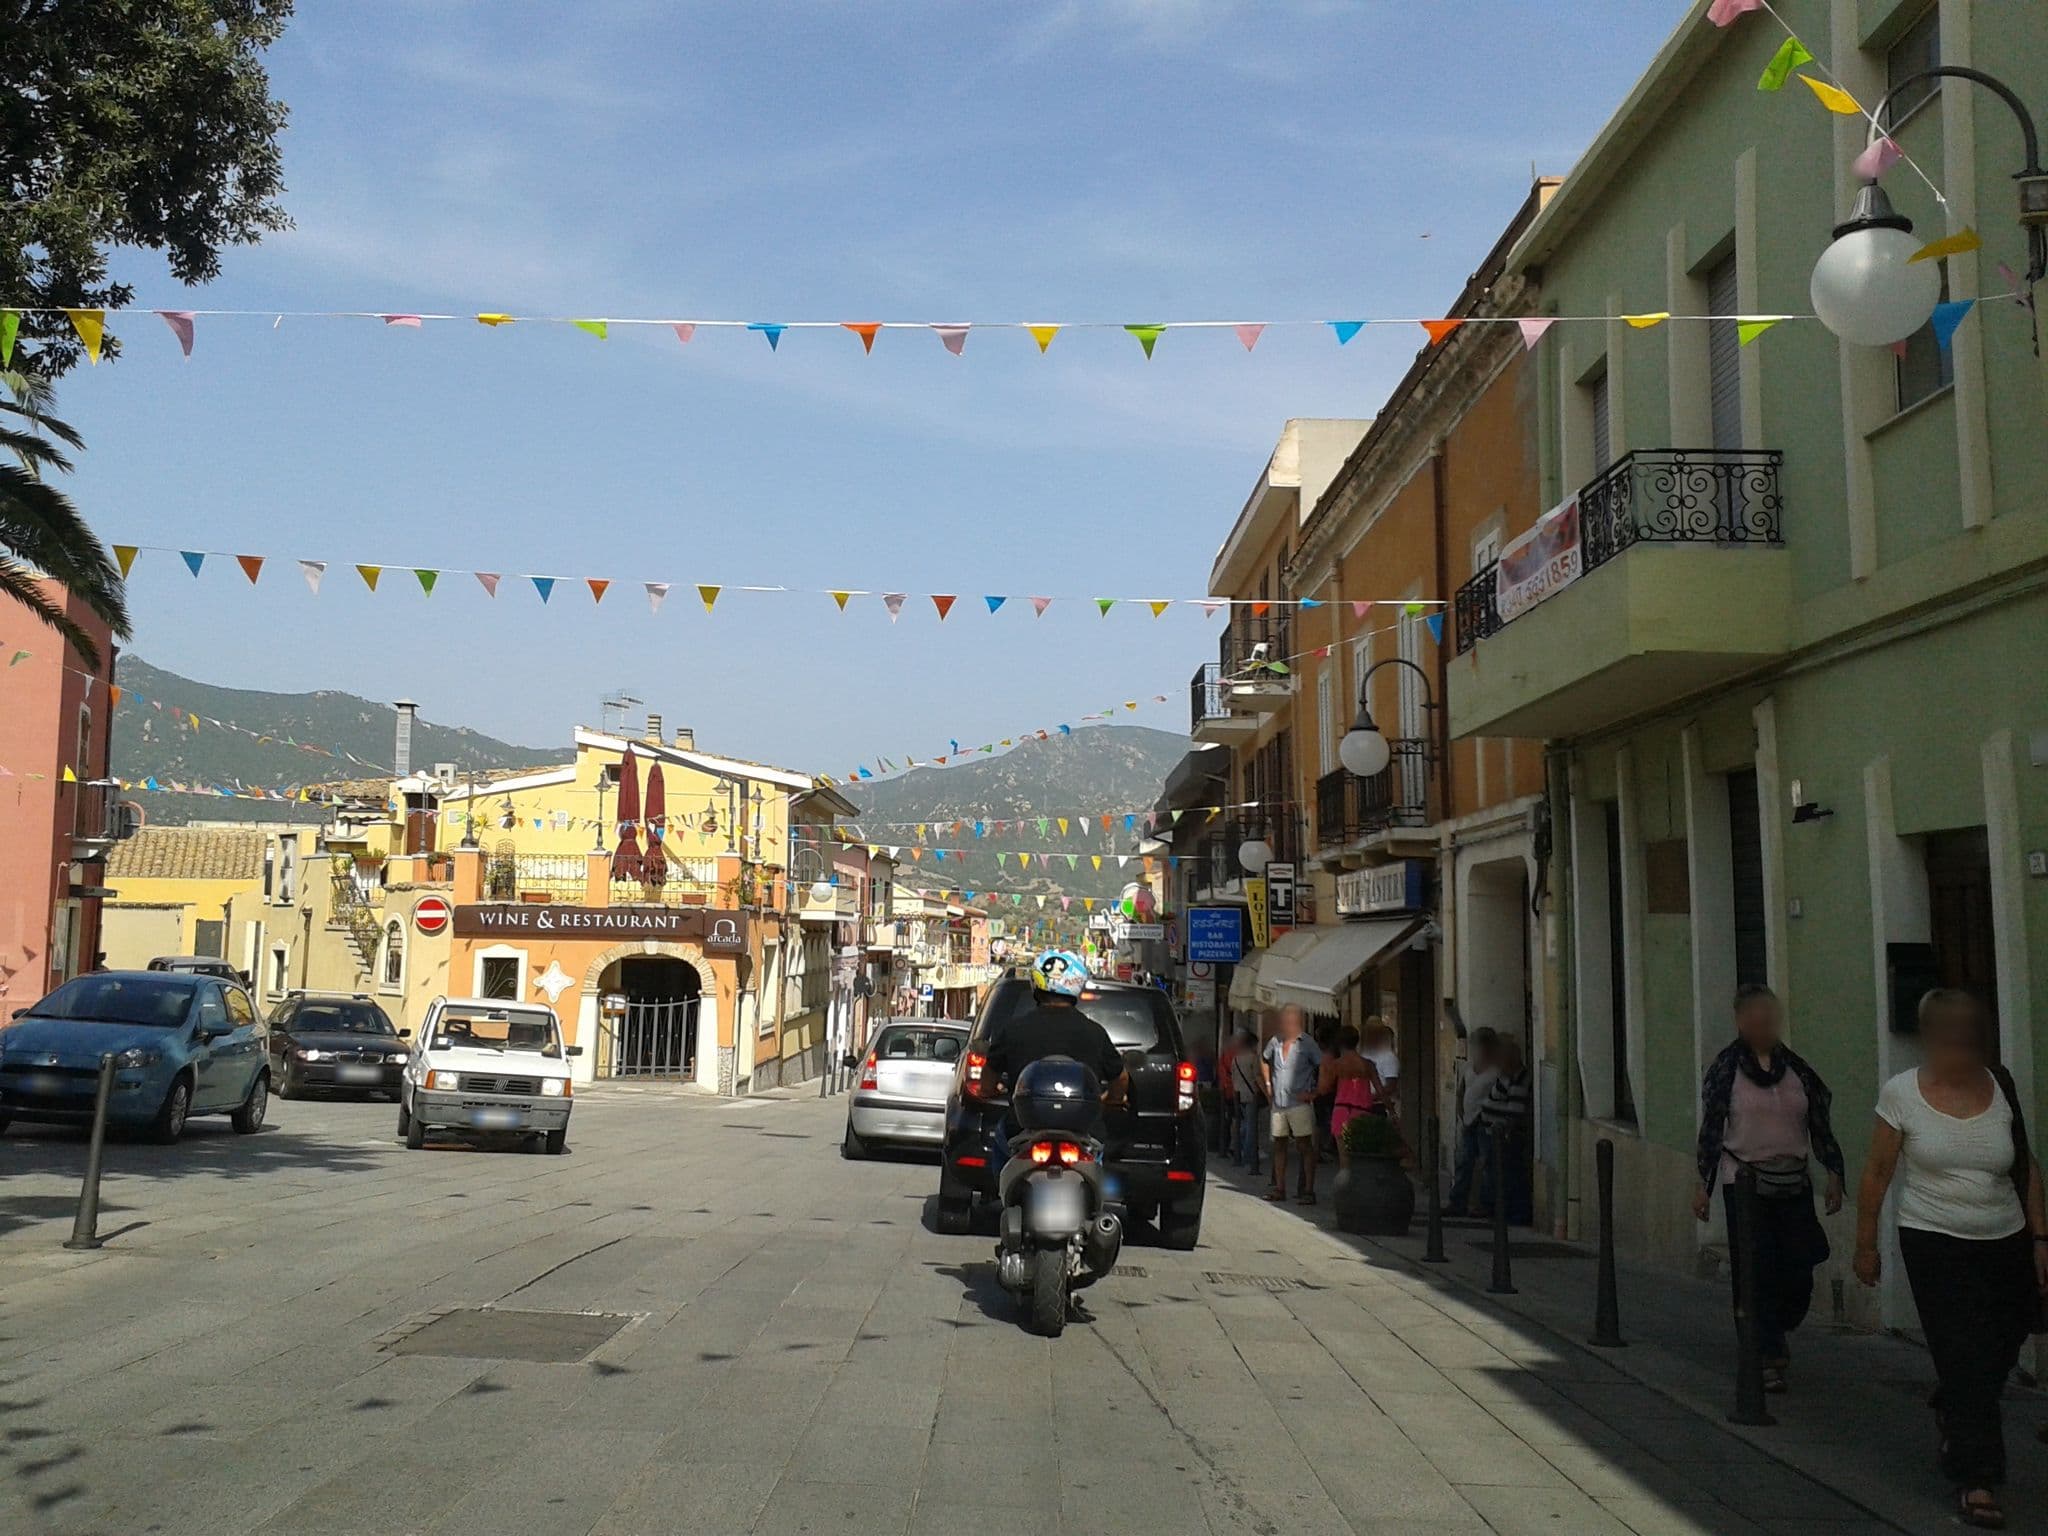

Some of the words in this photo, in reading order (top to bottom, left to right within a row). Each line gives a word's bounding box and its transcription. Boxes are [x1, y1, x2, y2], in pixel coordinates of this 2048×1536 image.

[479, 912, 529, 926] WINE
[537, 910, 555, 929] &
[560, 913, 680, 929] RESTAURANT
[1252, 892, 1265, 942] LOTTO
[707, 933, 741, 944] arcada
[1207, 932, 1223, 940] BAR
[1191, 941, 1240, 949] RISTORANTE
[1198, 950, 1233, 958] PIZZERIA
[923, 984, 931, 996] P
